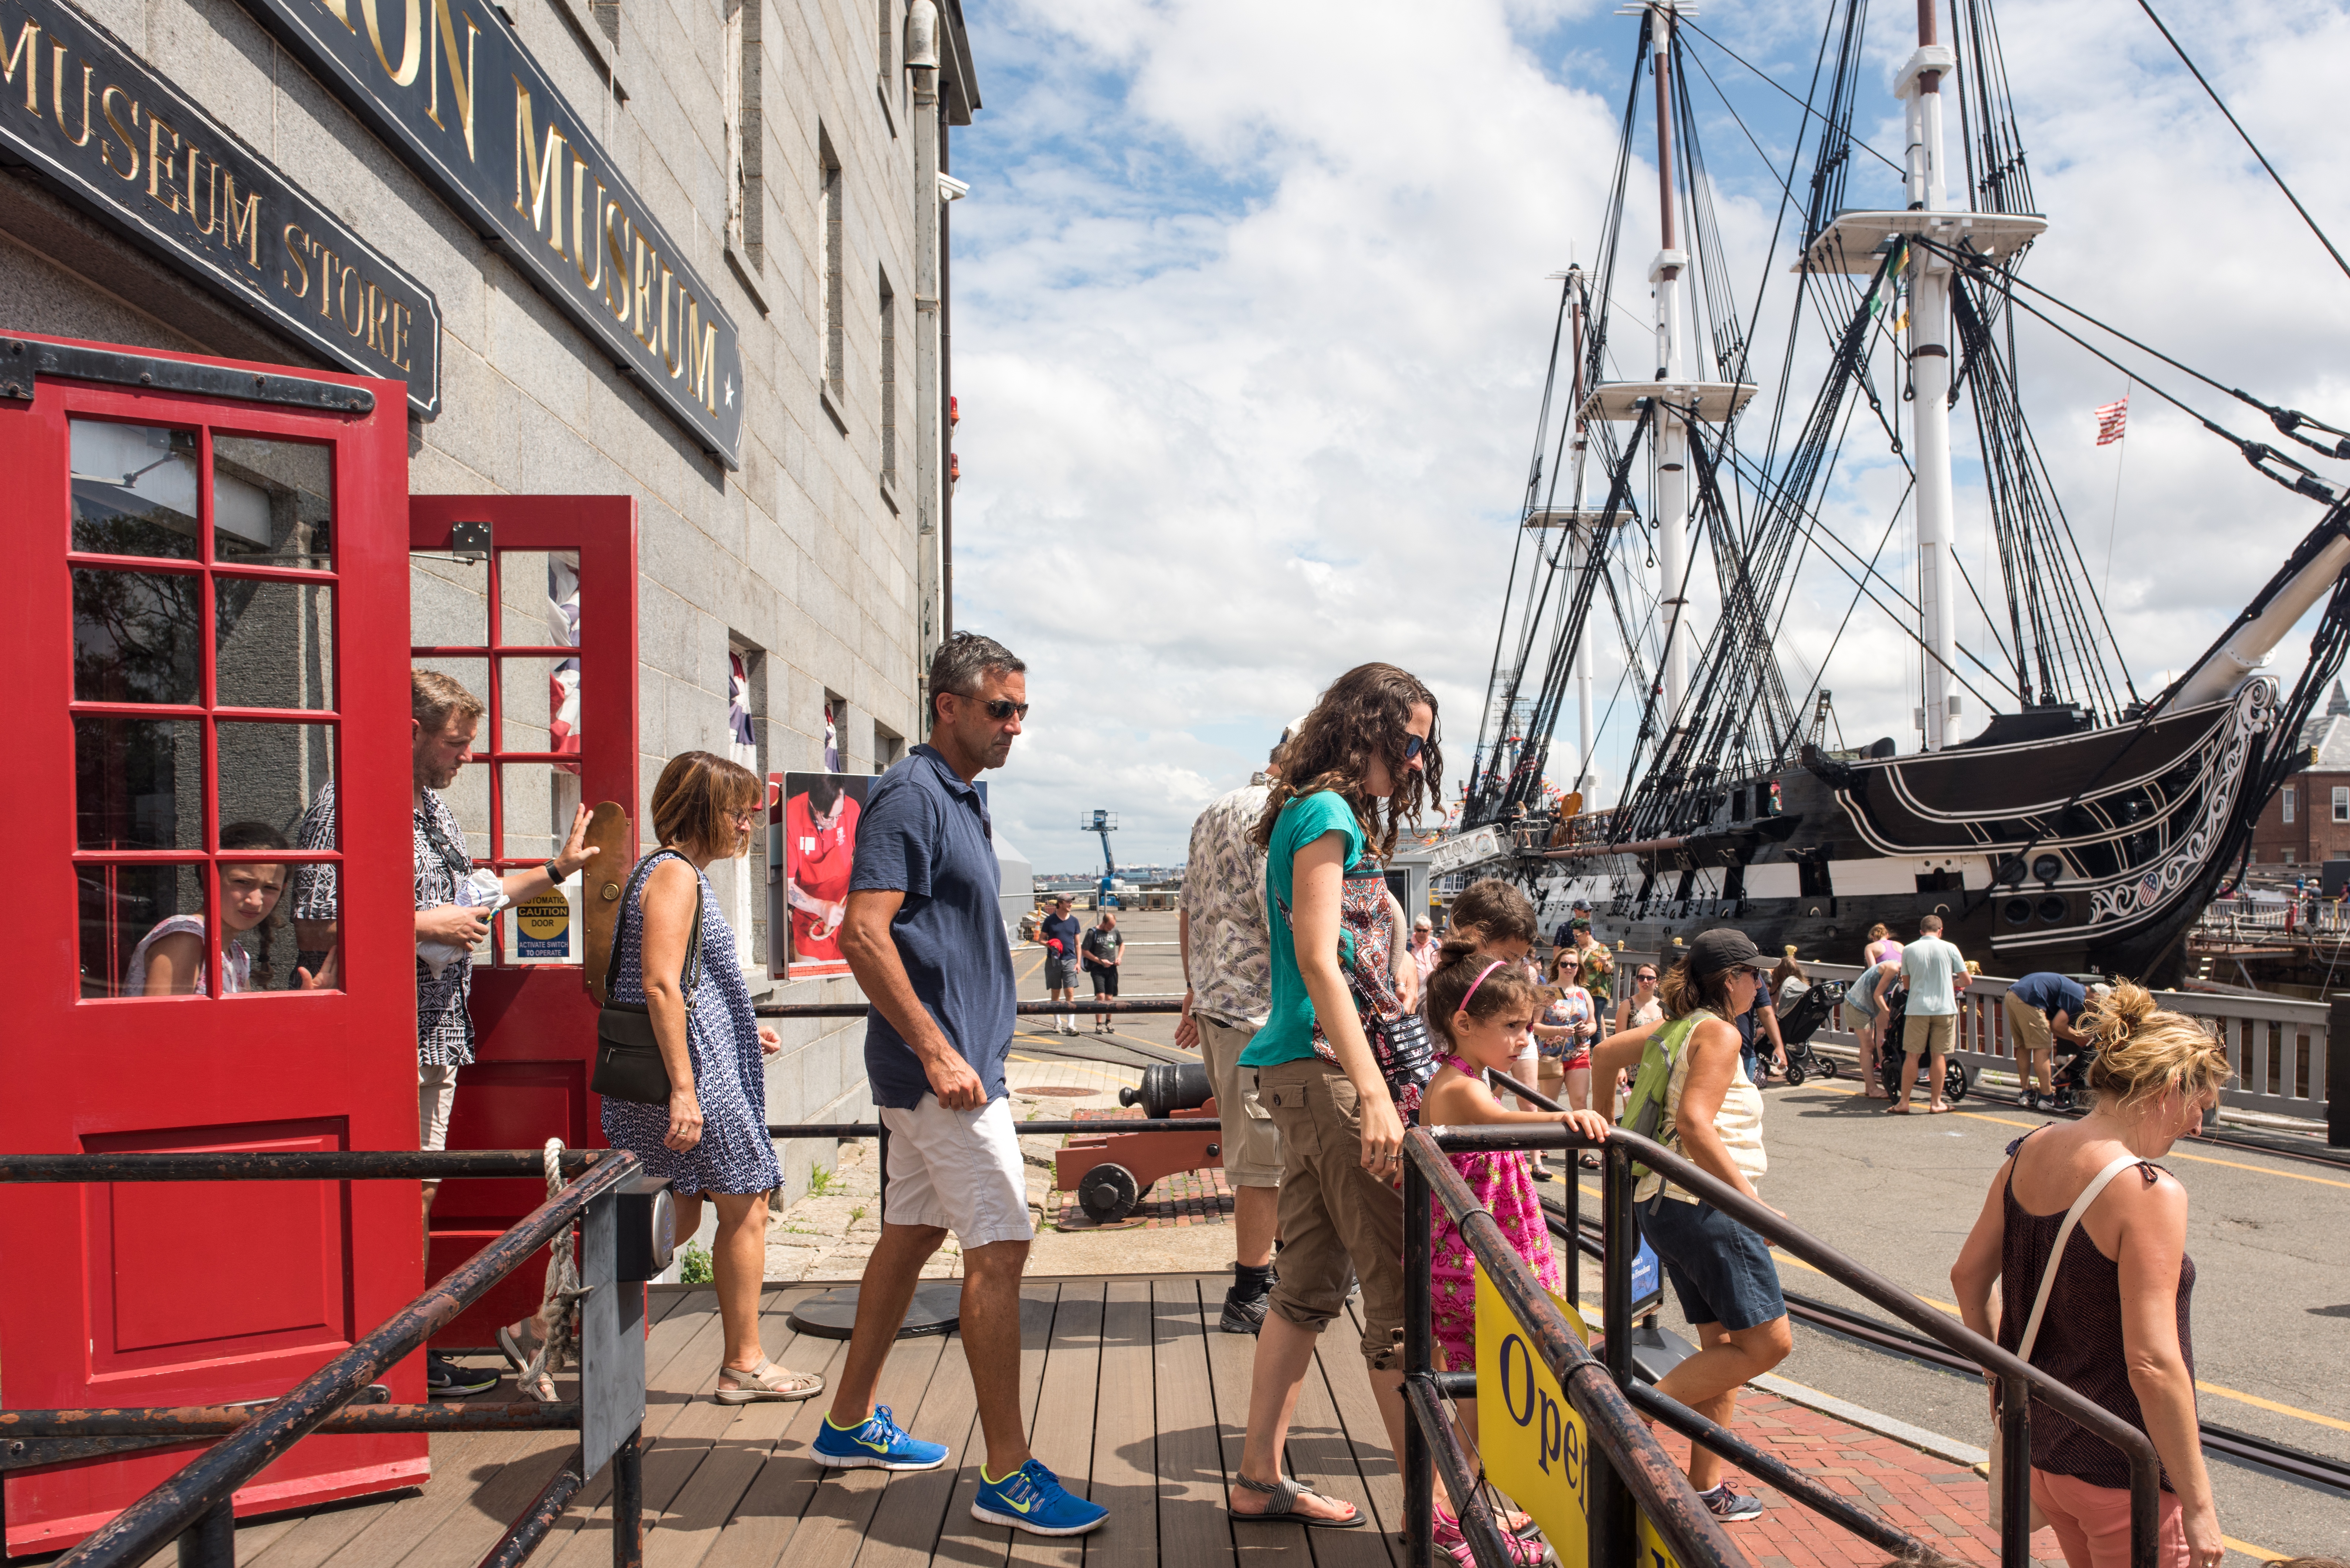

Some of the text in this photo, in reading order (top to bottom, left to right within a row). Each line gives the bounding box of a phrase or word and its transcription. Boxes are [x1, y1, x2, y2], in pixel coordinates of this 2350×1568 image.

[0, 18, 412, 373] MUSEUM STORE
[512, 72, 718, 420] MUSEUM
[2091, 965, 2100, 974] 24
[1635, 1265, 1650, 1278] Freedom
